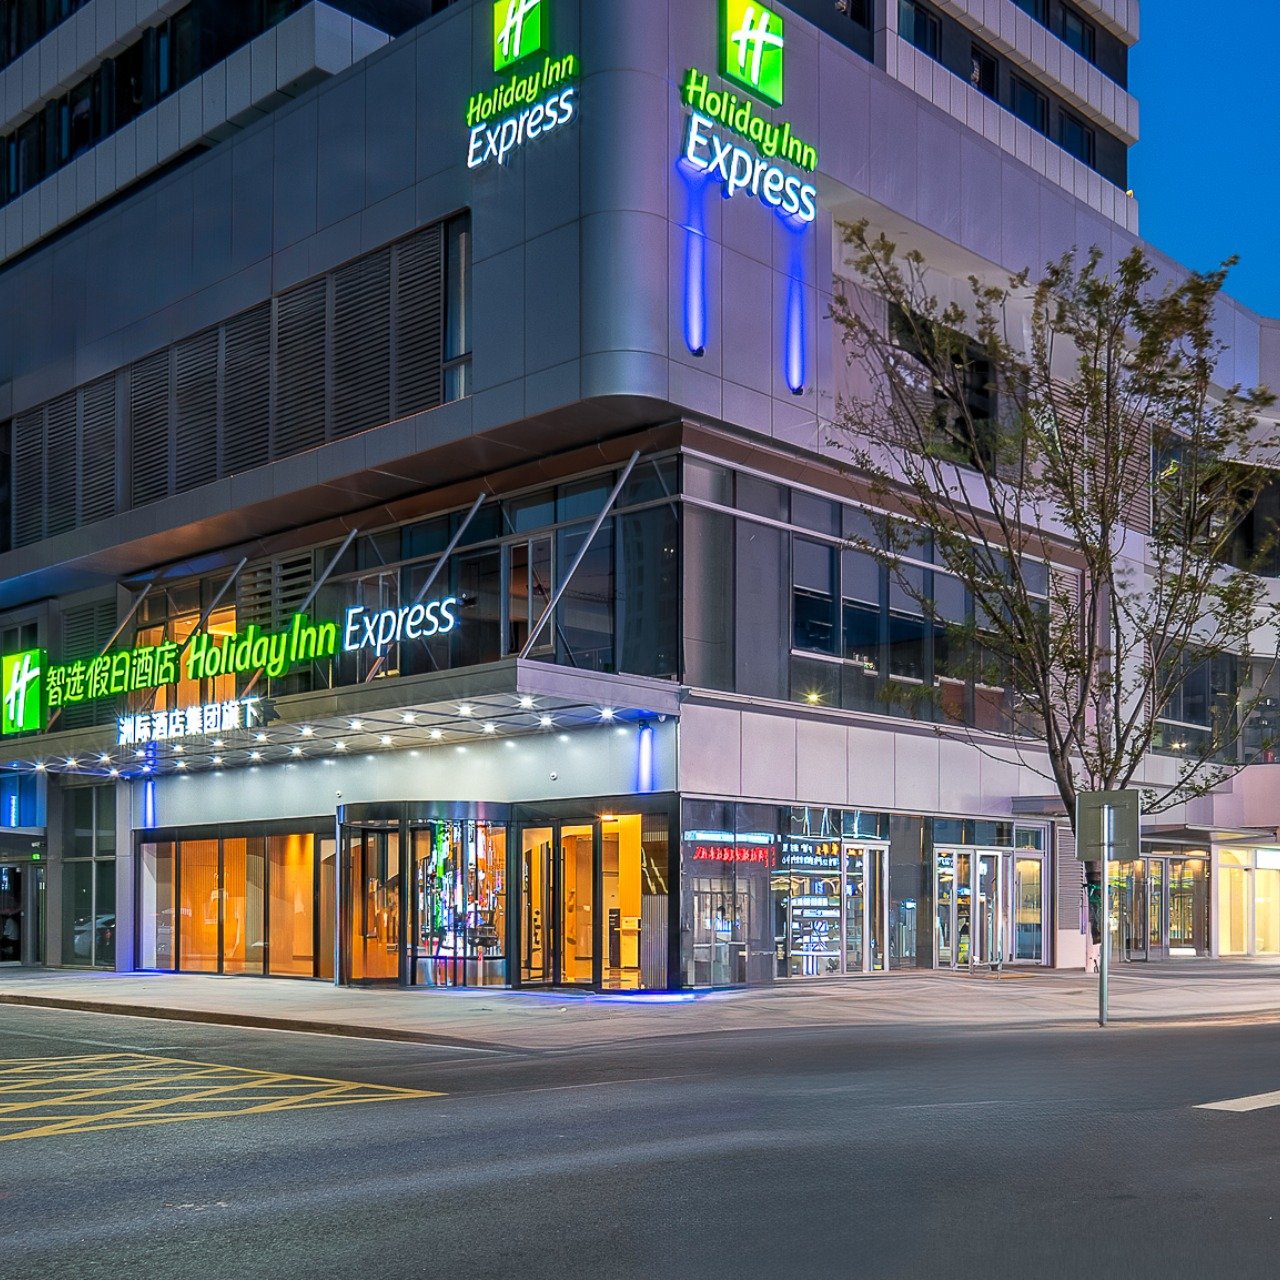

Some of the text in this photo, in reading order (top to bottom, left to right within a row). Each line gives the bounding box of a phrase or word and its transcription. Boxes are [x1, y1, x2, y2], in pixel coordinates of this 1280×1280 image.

[467, 54, 574, 126] Holiday Inn
[467, 88, 574, 169] Express
[686, 67, 818, 172] Holiday Inn
[687, 111, 817, 223] Express
[46, 641, 177, 707] 智选假日酒店
[187, 597, 457, 679] Holiday Inn Express
[118, 695, 260, 746] 洲际酒店集团旗下
